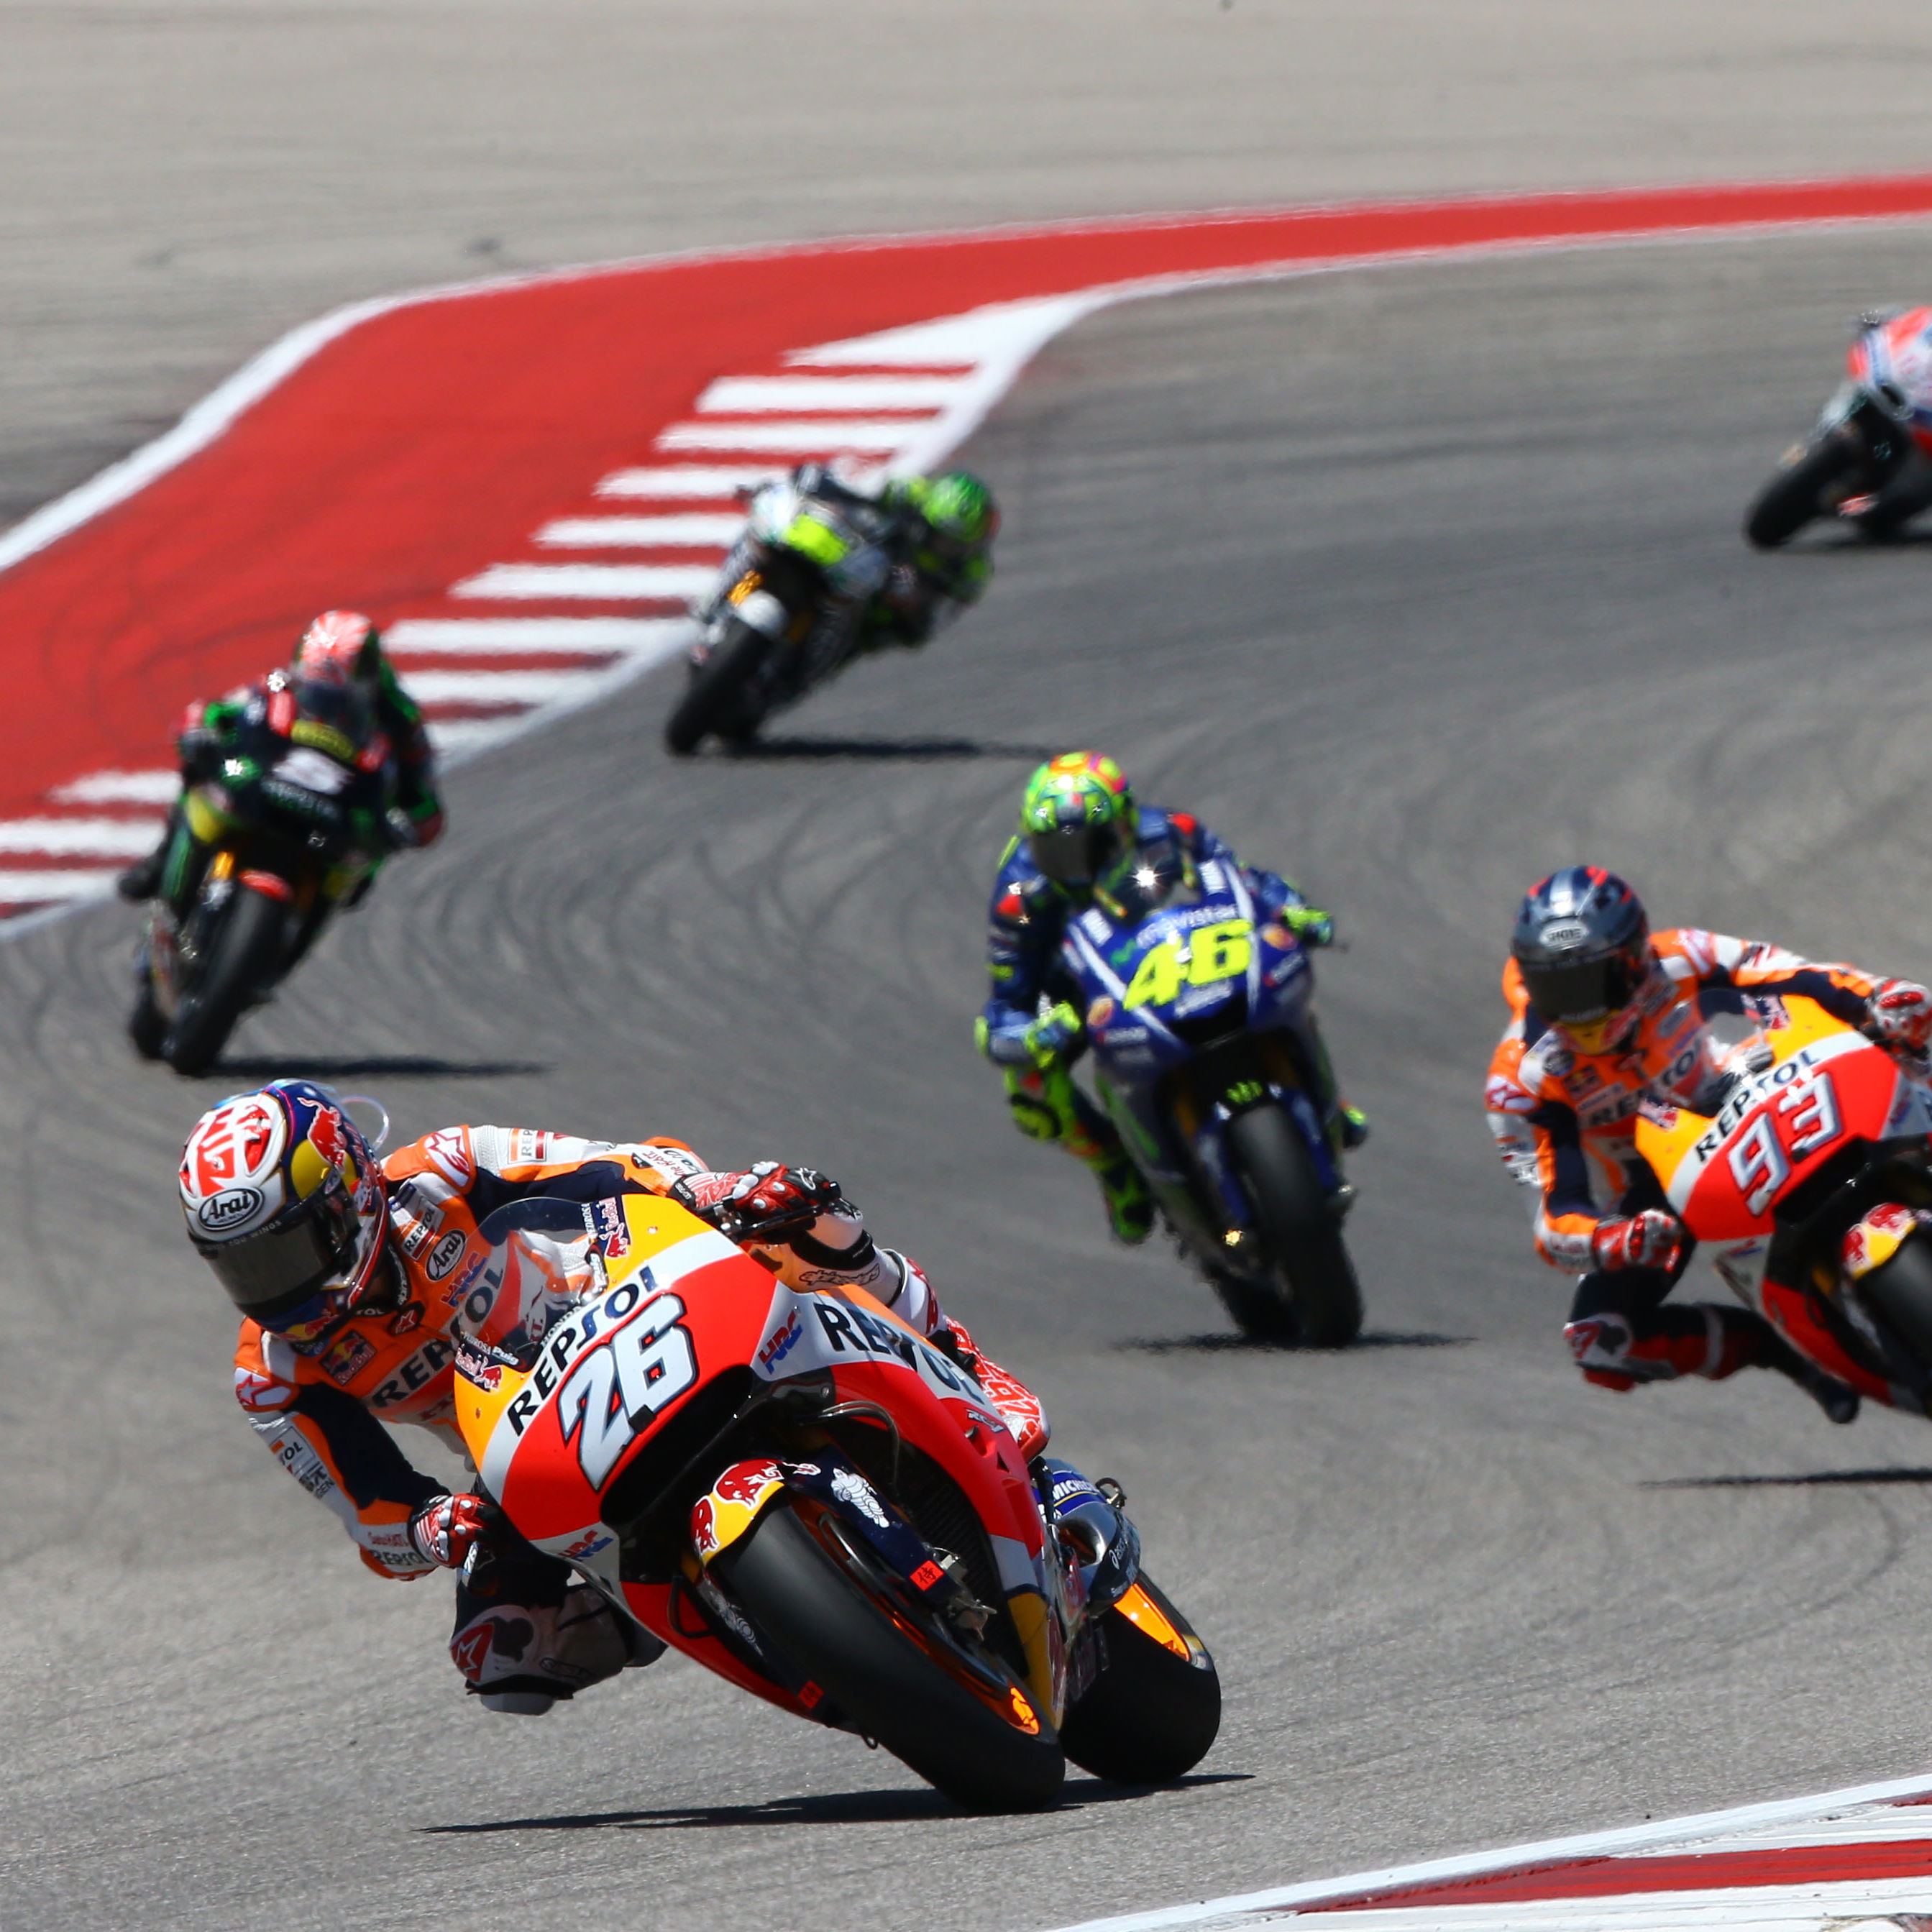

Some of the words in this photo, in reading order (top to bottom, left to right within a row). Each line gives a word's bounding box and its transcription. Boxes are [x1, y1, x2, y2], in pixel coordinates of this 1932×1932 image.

[1123, 918, 1253, 1010] 46
[1727, 1071, 1846, 1218] 93
[203, 1190, 252, 1224] Arai
[403, 1207, 436, 1253] REPSOL
[431, 1232, 462, 1280] Arai
[440, 1251, 489, 1308] HRC
[491, 1346, 519, 1365] Puig
[758, 1310, 803, 1375] HRC
[557, 1292, 700, 1495] 26
